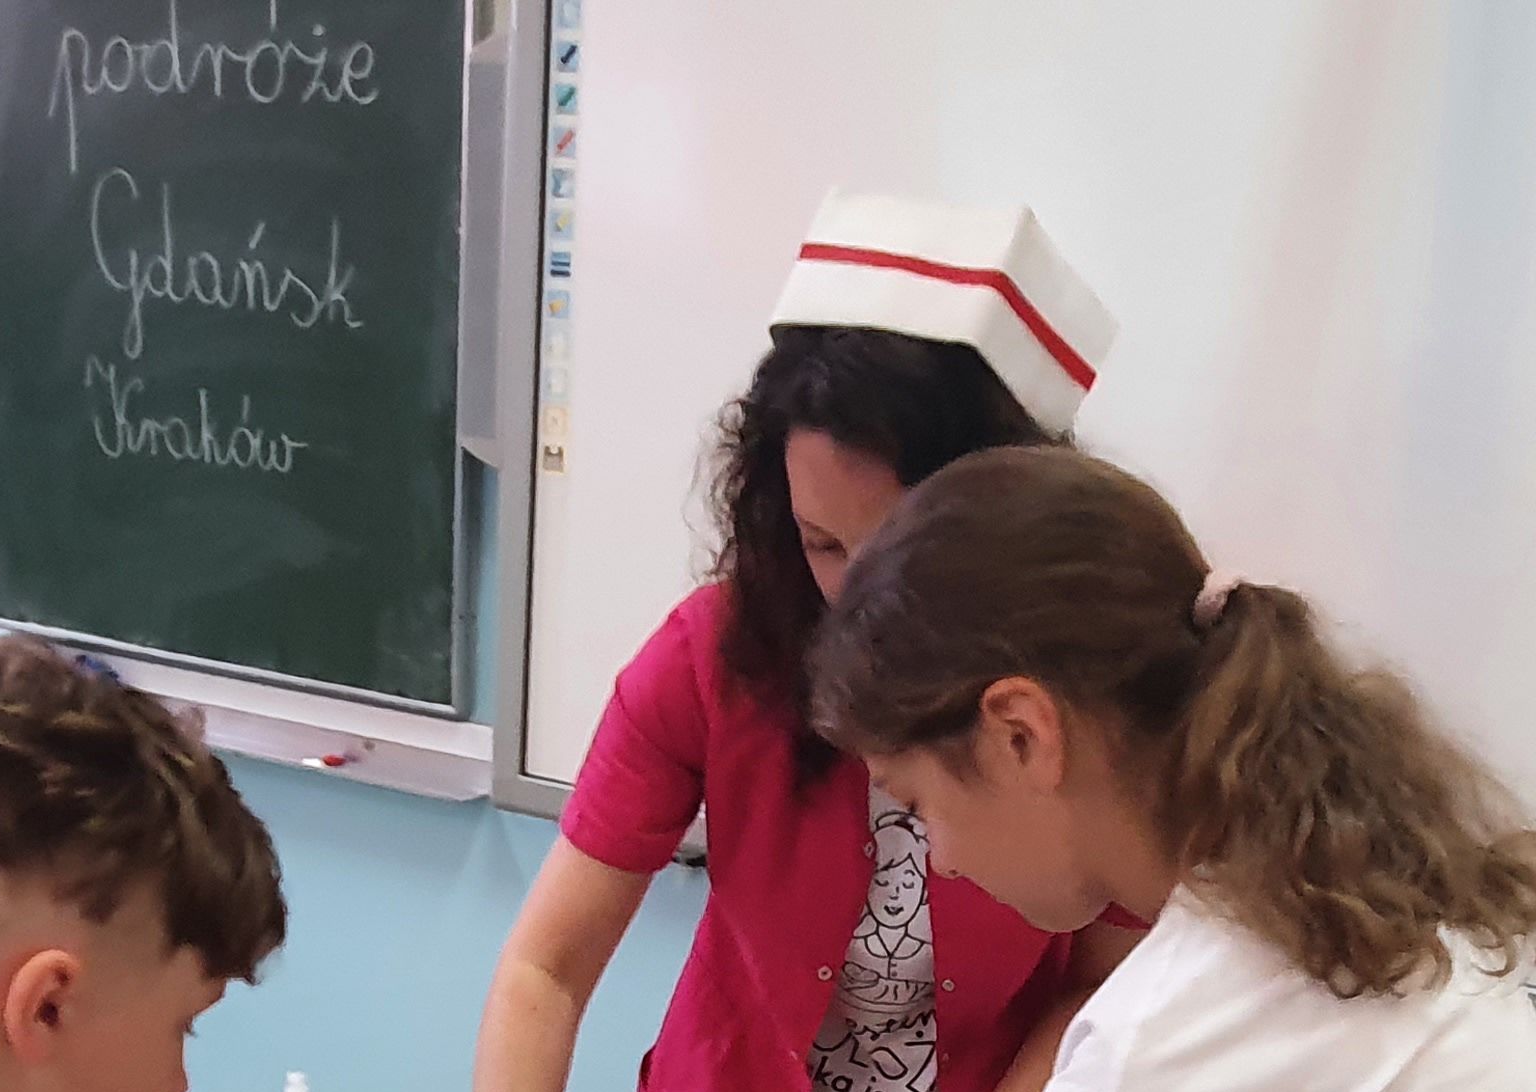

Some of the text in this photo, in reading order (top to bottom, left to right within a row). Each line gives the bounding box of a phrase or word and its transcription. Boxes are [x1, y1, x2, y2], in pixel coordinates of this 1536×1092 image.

[47, 0, 379, 174] podróże
[90, 166, 364, 361] Gdańsk
[83, 354, 309, 473] Kraków
